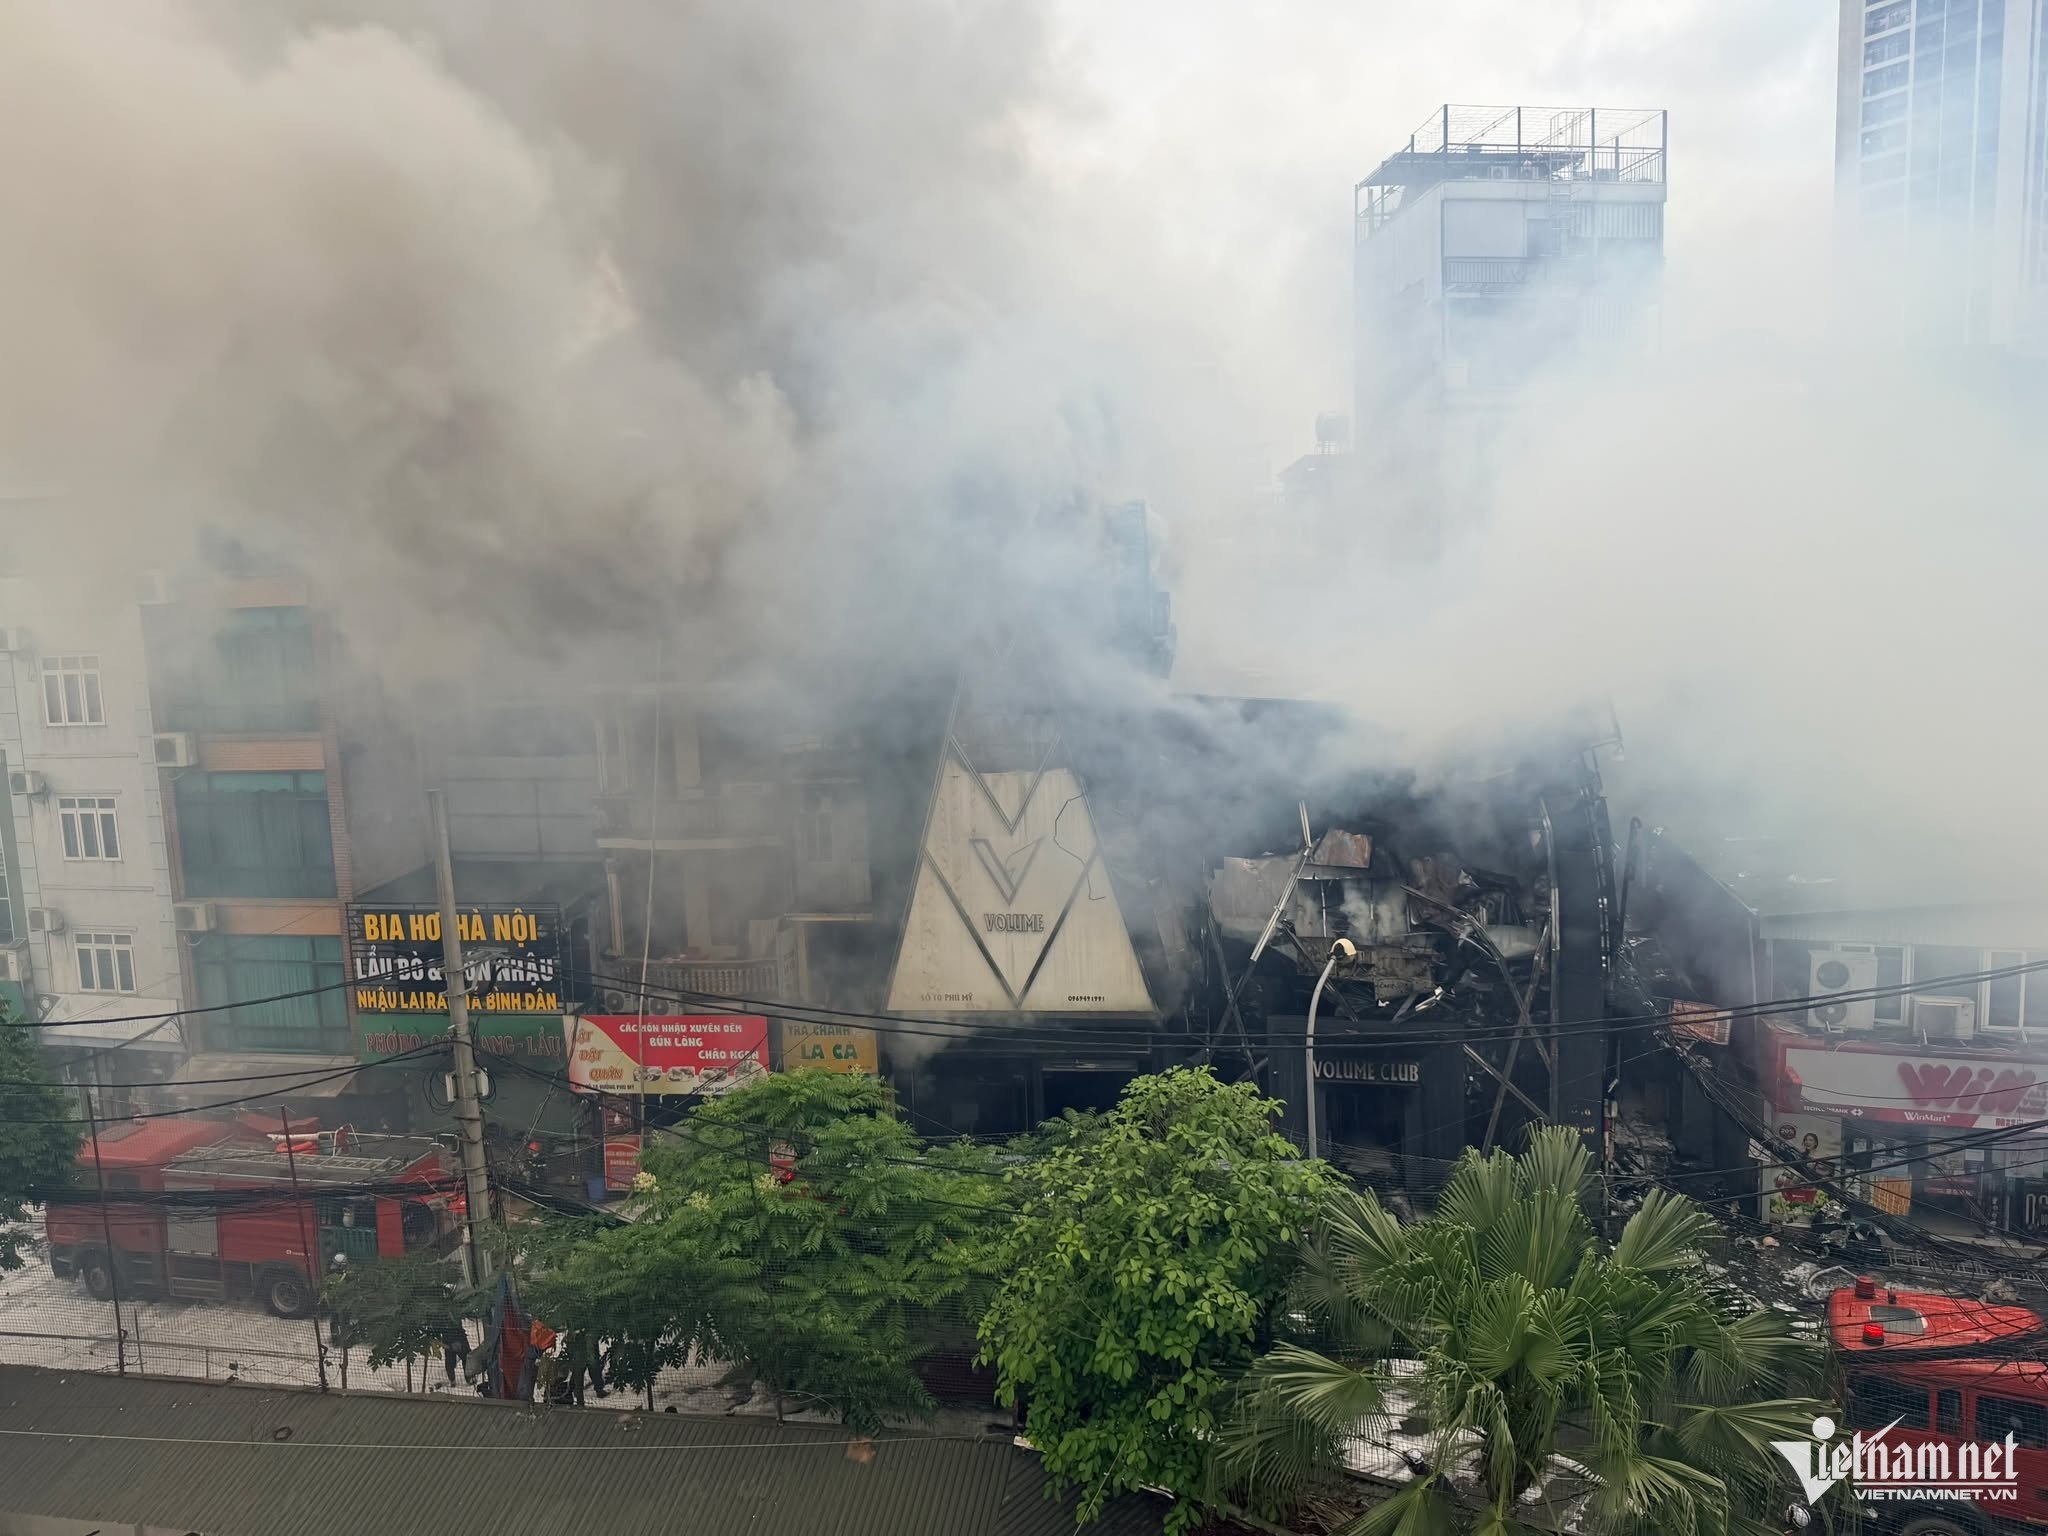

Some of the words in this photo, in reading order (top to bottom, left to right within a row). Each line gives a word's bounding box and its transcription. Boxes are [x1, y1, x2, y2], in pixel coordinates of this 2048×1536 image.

[364, 914, 405, 940] BIA
[410, 911, 442, 940] HƠ
[457, 908, 487, 940] HÀ
[493, 907, 538, 948] NỘI
[984, 913, 1044, 932] VOLUME
[356, 945, 392, 981] LẨU
[398, 951, 423, 981] BÒ
[445, 951, 491, 981] ÓN
[497, 952, 554, 986] NHẬU
[358, 985, 397, 1012] NHẬU
[400, 991, 424, 1009] LAI
[427, 991, 448, 1009] RA
[466, 986, 482, 1010] IÁ
[486, 986, 521, 1010] BÌNH
[525, 988, 557, 1010] DÂN
[649, 1035, 671, 1047] BÚN
[800, 1044, 825, 1059] LA
[1312, 1060, 1375, 1080] VOLUME
[1381, 1063, 1419, 1081] CLUB
